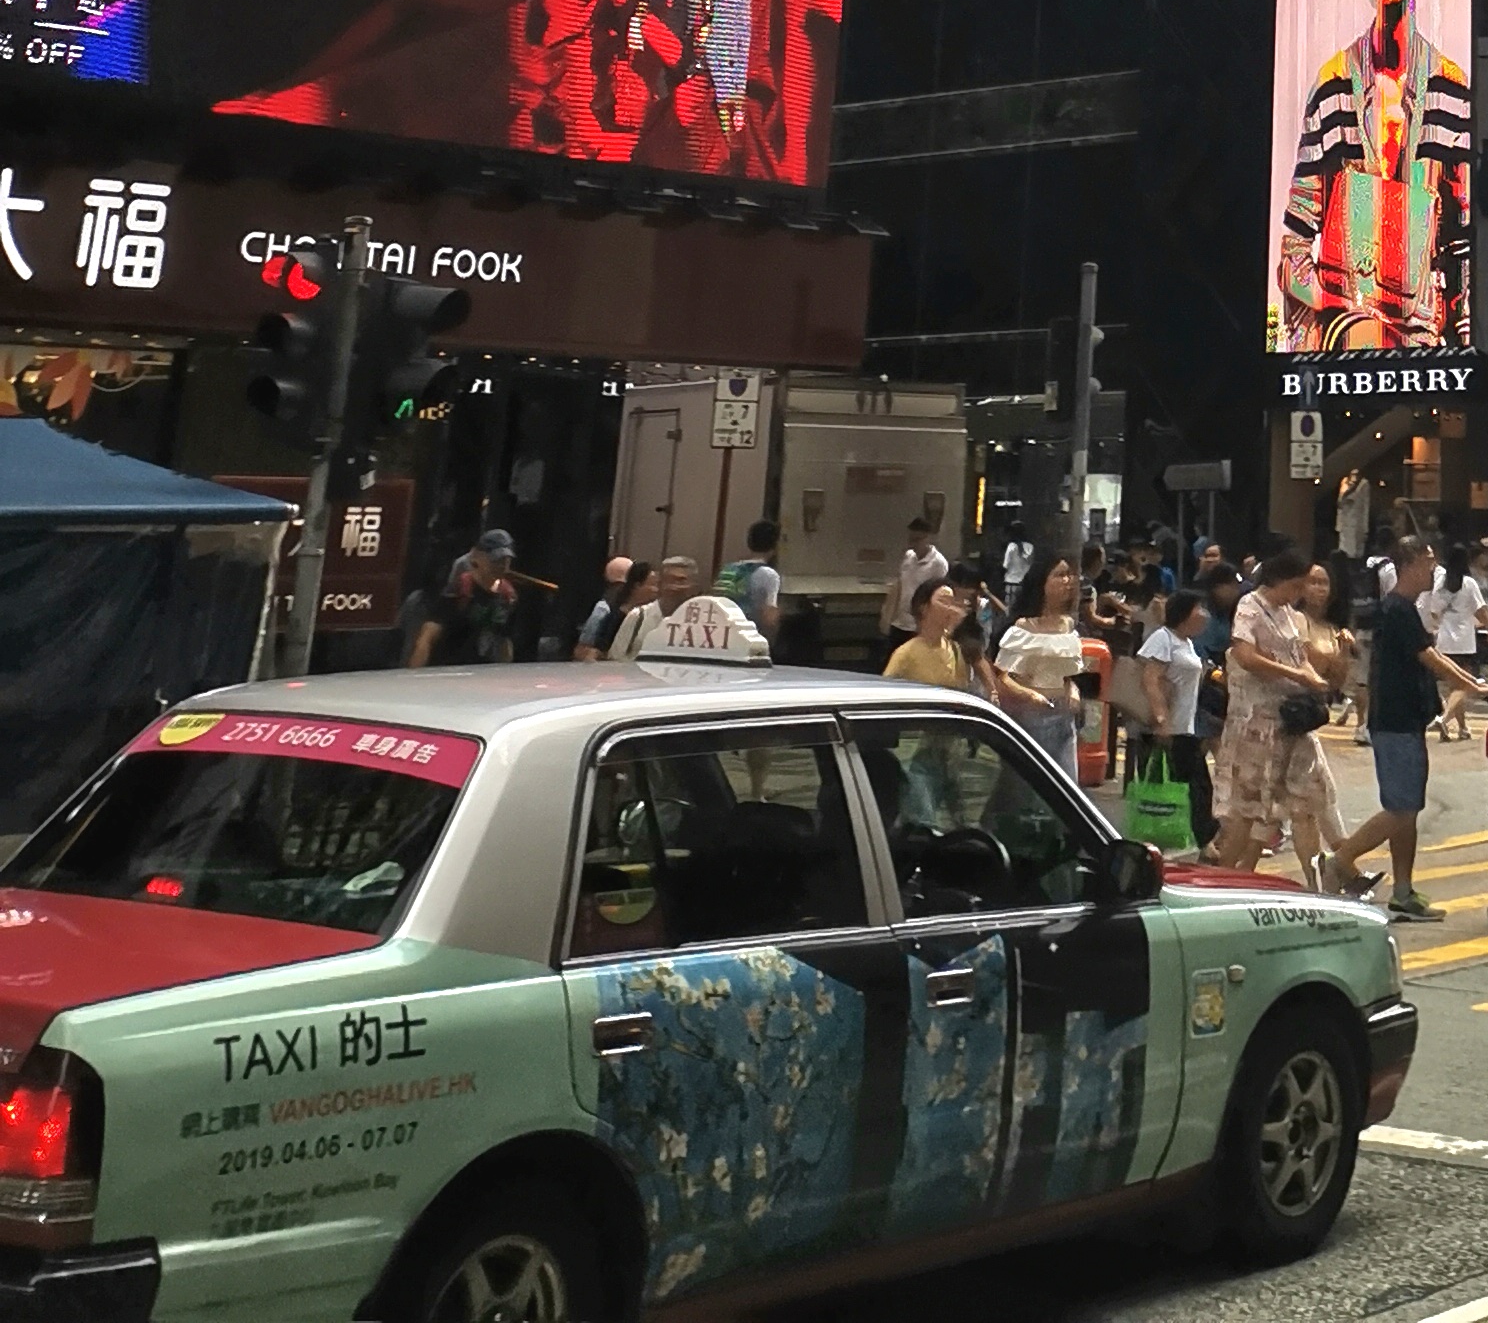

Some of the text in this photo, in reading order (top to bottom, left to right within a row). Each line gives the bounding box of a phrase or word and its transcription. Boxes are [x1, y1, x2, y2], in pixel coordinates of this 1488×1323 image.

[25, 37, 86, 65] OFF
[366, 241, 416, 276] TAI
[431, 246, 523, 284] FOOK
[341, 506, 382, 558] 福
[320, 593, 374, 612] FOOK
[667, 622, 732, 649] TAXI
[221, 721, 281, 742] 2751
[278, 725, 342, 748] 6666
[213, 1002, 428, 1083] TAXI 的士
[360, 1120, 419, 1152] 07.07
